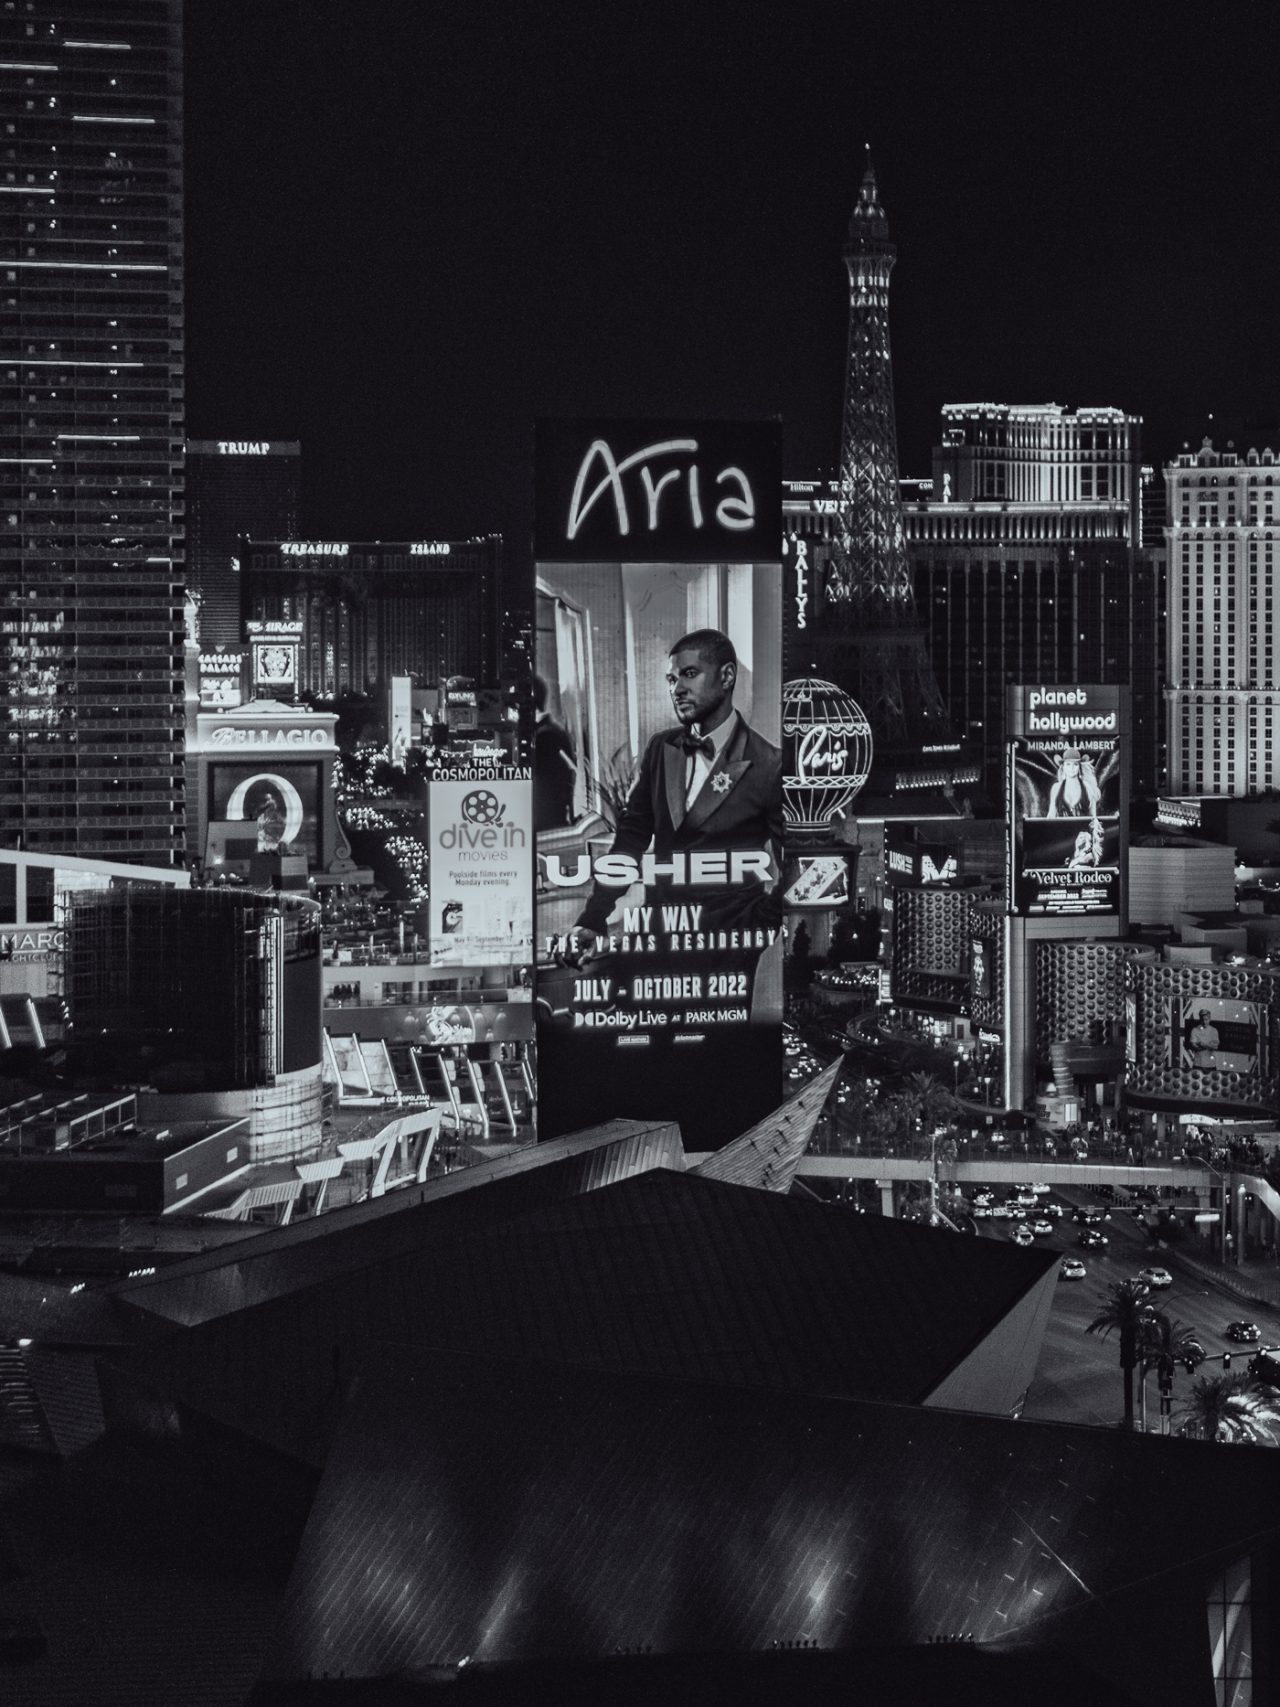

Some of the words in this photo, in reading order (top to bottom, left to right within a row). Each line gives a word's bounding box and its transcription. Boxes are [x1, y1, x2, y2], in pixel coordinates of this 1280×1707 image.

[217, 441, 270, 456] TRUMP
[567, 439, 755, 539] Aria
[790, 484, 814, 492] Hilton
[280, 543, 350, 556] TREASURE
[410, 543, 451, 555] ISLAND
[1030, 687, 1087, 710] planet
[1030, 711, 1116, 734] hollywood
[211, 726, 329, 748] BELLAGIO
[1027, 741, 1070, 751] MIRANDA
[1073, 740, 1116, 750] LAMBERT
[473, 757, 493, 768] THE
[800, 726, 848, 785] Paris
[432, 767, 532, 781] COSMOPOLITAN
[439, 823, 498, 850] dive
[503, 822, 526, 848] in
[458, 850, 508, 861] movies
[449, 870, 478, 879] Poolside
[499, 871, 518, 879] every
[546, 850, 774, 887] USHER
[1031, 870, 1073, 884] Velvet
[1075, 870, 1112, 884] Rodeo
[455, 879, 481, 887] Monday
[623, 906, 653, 934] MY
[662, 905, 703, 932] WAY
[546, 936, 579, 953] THE
[596, 934, 657, 953] VEGAS
[671, 929, 776, 952] RESIDENCY
[574, 978, 612, 1002] JULY
[633, 976, 702, 1000] OCTOBER
[709, 974, 747, 998] 2022
[595, 1011, 638, 1030] Dolby
[639, 1010, 667, 1026] Live
[671, 1014, 682, 1022] AT
[685, 1011, 716, 1024] PARK
[717, 1008, 747, 1022] MGM
